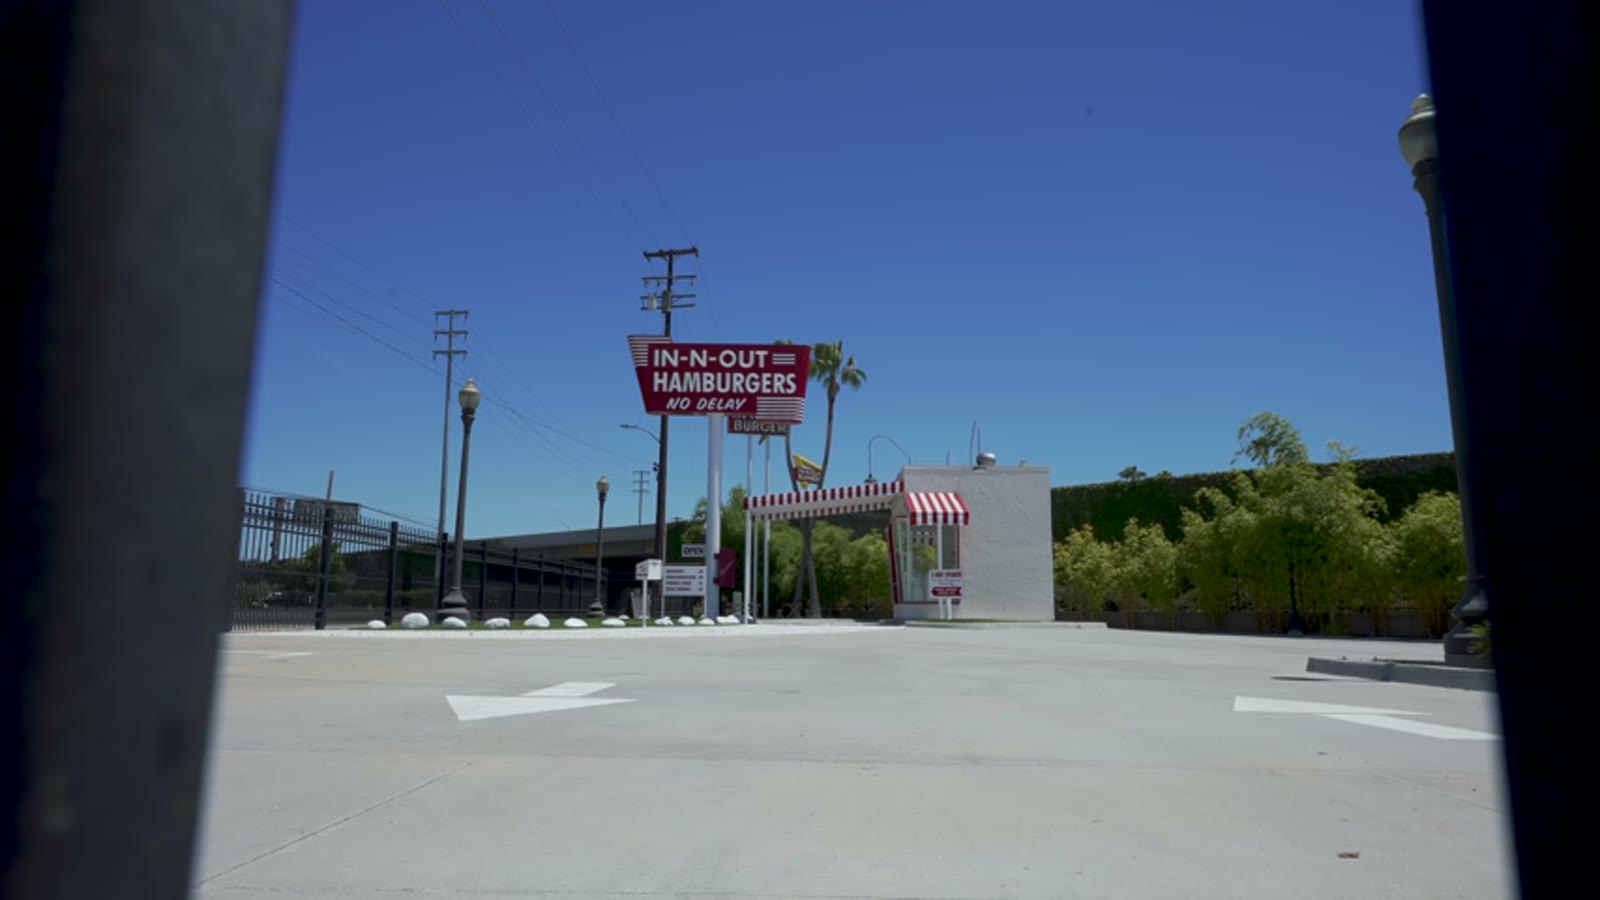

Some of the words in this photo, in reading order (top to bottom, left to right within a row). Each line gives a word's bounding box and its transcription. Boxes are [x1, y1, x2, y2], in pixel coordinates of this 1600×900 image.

[653, 349, 768, 368] IN-N-OUT
[653, 372, 797, 394] HAMBURGERS
[666, 397, 690, 410] NO
[696, 397, 746, 410] DELAY
[734, 420, 787, 433] BURGER
[683, 546, 704, 556] OPEN
